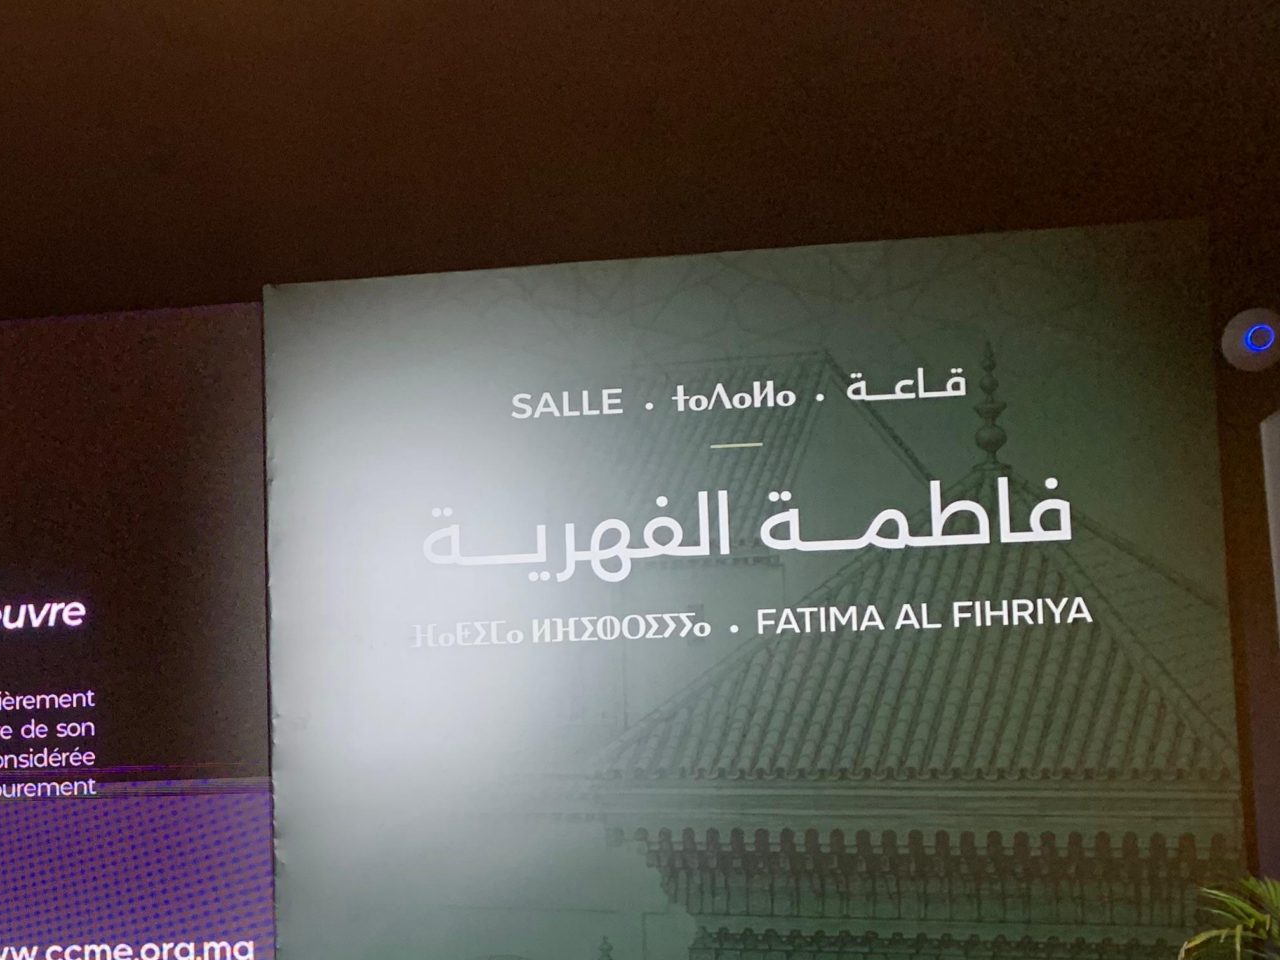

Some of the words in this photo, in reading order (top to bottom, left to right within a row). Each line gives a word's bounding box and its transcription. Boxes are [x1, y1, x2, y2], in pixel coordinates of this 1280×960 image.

[846, 367, 967, 401] قاعة
[511, 389, 624, 419] SALLE
[760, 476, 1073, 552] فاطمة
[422, 490, 731, 583] الفهرية
[757, 605, 885, 635] FATIMA
[895, 602, 943, 630] AL
[952, 596, 1094, 626] FIHRIYA
[21, 719, 48, 739] de
[56, 721, 96, 738] son
